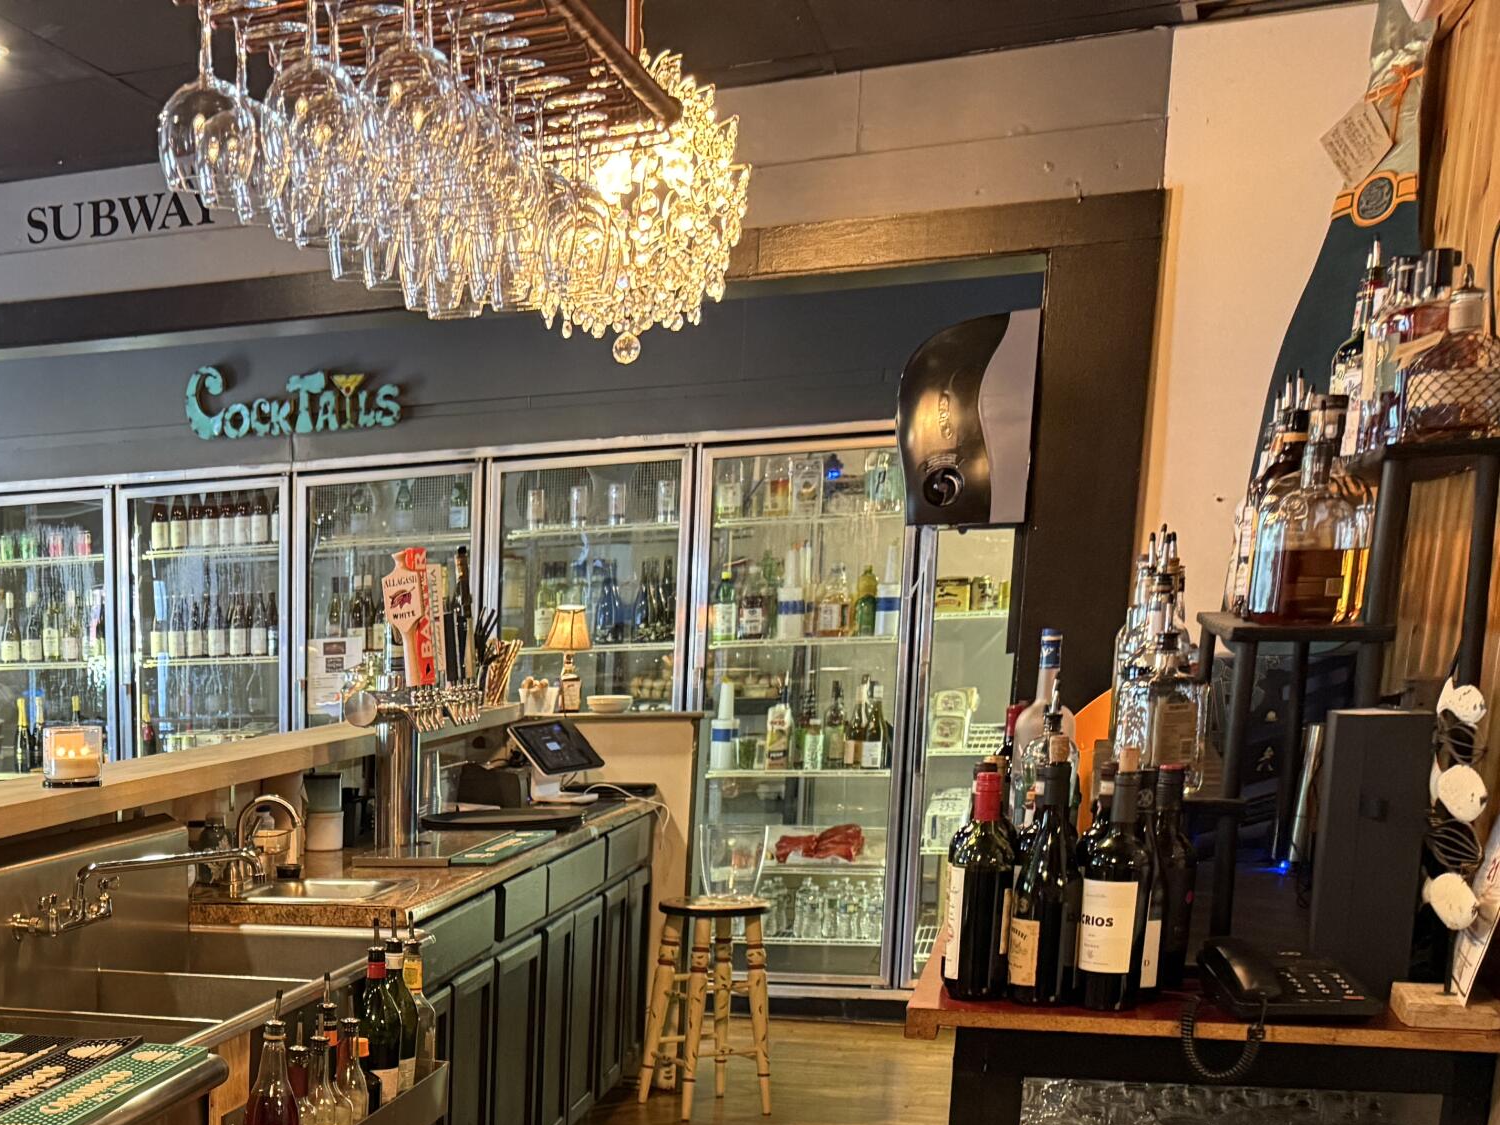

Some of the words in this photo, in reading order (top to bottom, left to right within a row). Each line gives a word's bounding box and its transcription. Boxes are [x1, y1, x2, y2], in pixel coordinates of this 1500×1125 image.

[27, 192, 215, 244] SUBWAY
[383, 574, 418, 589] ALLAGASH
[392, 610, 417, 621] WHITE
[1079, 913, 1114, 928] CRIOS
